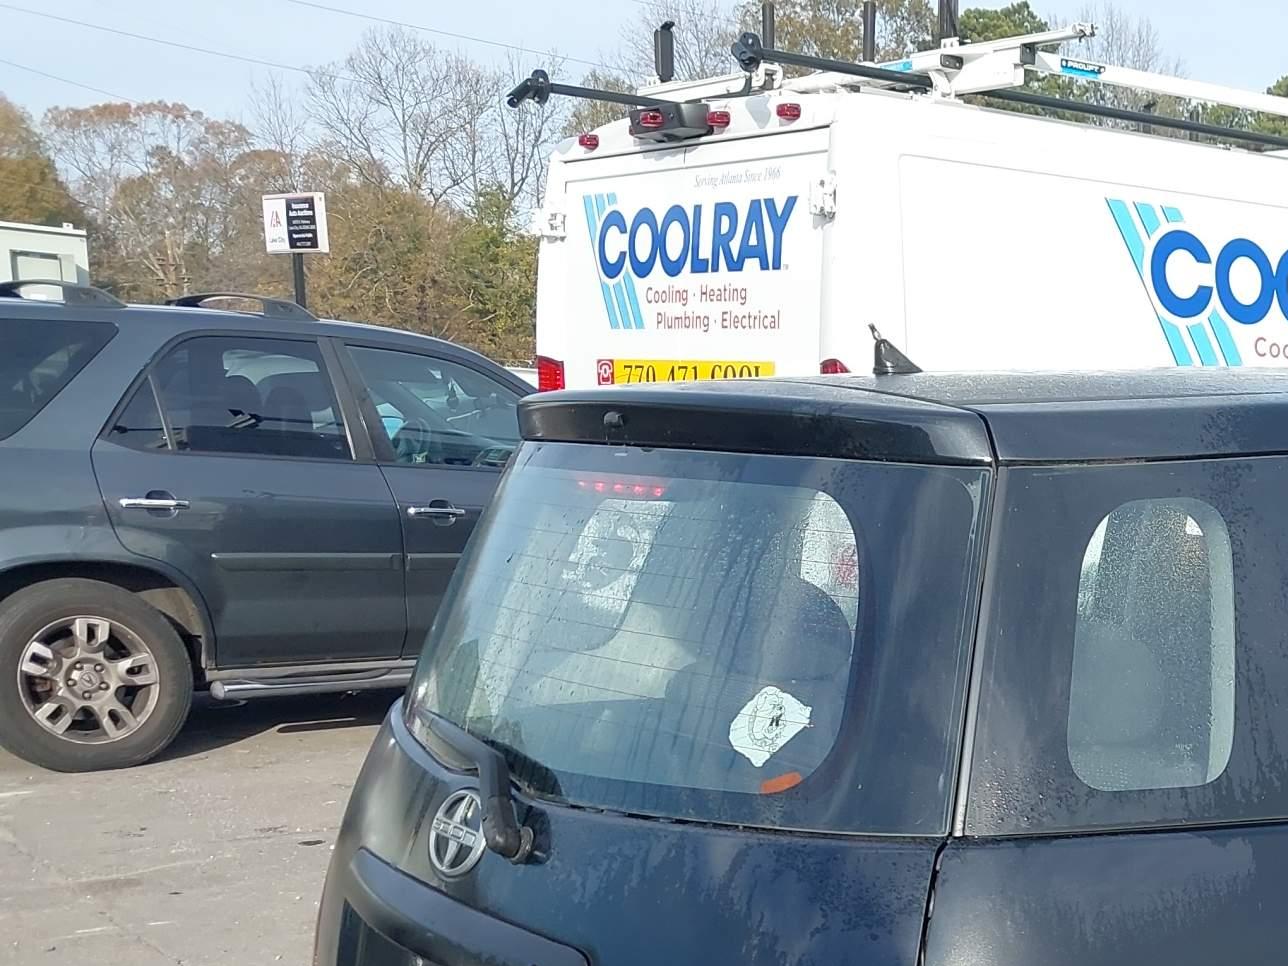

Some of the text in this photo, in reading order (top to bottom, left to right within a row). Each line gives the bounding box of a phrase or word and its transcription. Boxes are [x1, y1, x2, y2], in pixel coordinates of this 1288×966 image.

[600, 195, 798, 279] COOLRAY
[646, 283, 747, 306] Cooling Heating
[656, 309, 780, 332] Plumbing Electrical
[624, 365, 656, 383] 770
[668, 365, 697, 381] 471
